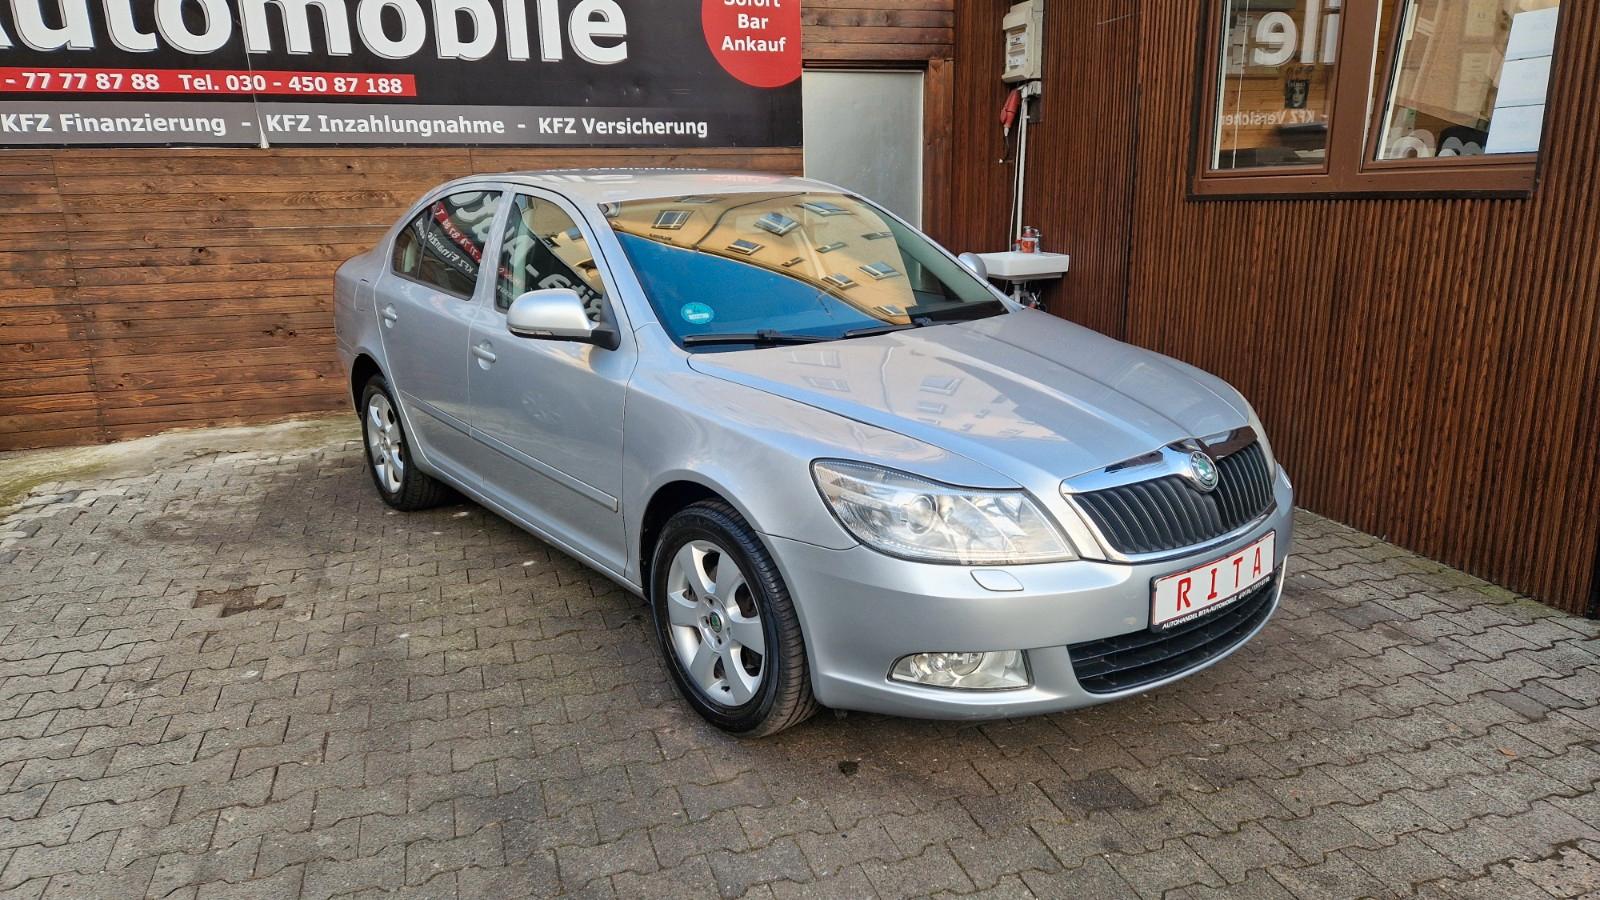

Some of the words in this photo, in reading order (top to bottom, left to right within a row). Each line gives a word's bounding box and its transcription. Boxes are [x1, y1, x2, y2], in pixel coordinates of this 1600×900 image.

[0, 0, 628, 64] utomobile
[737, 13, 769, 30] Bar
[721, 35, 787, 52] Ankauf
[22, 72, 51, 89] 77
[58, 73, 87, 90] 77
[95, 73, 123, 90] 87
[131, 73, 160, 90] 88
[178, 74, 219, 91] Tel.
[225, 75, 267, 91] 030
[288, 76, 328, 92] 450
[333, 77, 358, 93] 87
[366, 78, 403, 94] 188
[0, 113, 52, 132] KFZ
[60, 113, 226, 137] Finanzierung
[266, 114, 312, 132] KFZ
[318, 115, 505, 137] Inzahlungnahme
[539, 117, 576, 134] KFZ
[582, 117, 708, 138] Versicherung
